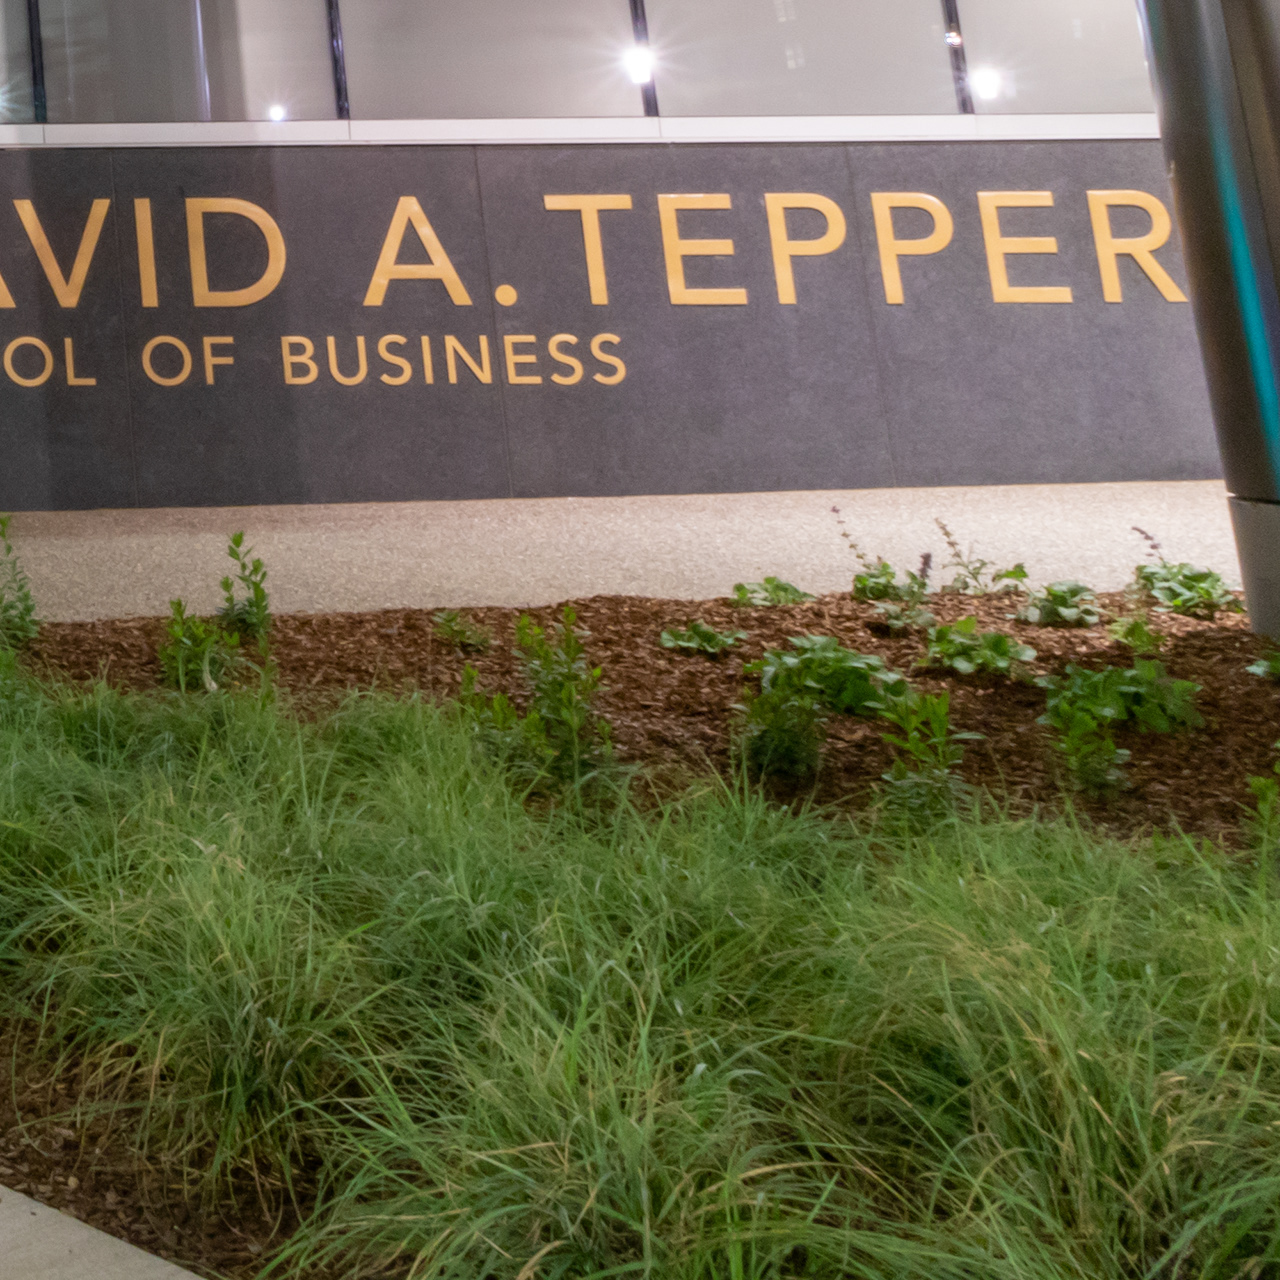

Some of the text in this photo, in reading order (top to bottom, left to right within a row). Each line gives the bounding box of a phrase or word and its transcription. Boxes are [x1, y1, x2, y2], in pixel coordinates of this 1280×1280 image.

[364, 196, 519, 308] A.
[544, 190, 1189, 306] TEPPER
[142, 336, 235, 387] OF
[282, 333, 628, 387] BUSINESS
